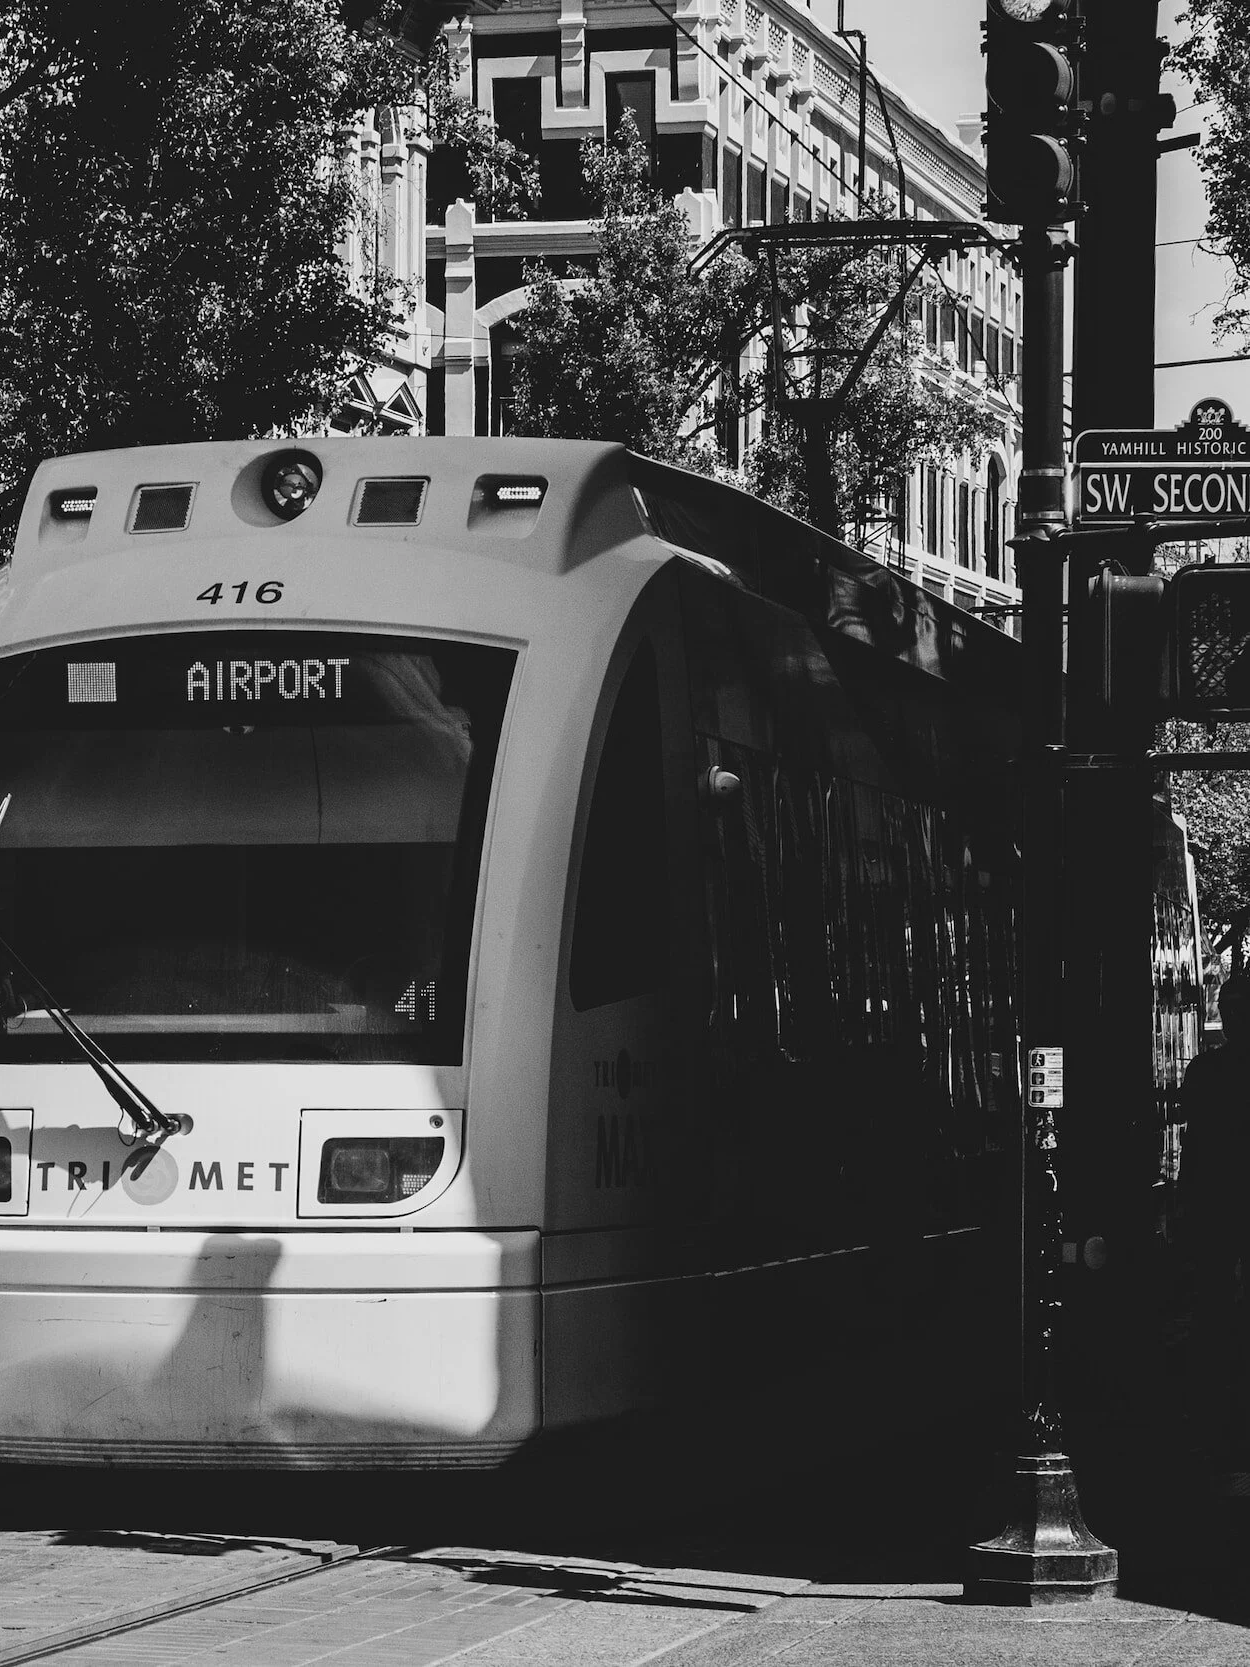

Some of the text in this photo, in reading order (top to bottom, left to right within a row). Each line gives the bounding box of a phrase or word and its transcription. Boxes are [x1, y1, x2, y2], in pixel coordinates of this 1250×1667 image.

[1102, 441, 1247, 455] YAMHILL HISTORIC
[1199, 427, 1223, 440] 200
[1086, 473, 1250, 513] SW SECON
[196, 581, 285, 605] 416
[187, 658, 350, 701] AIRPORT
[394, 980, 436, 1021] 41
[36, 1160, 290, 1192] TRI MET
